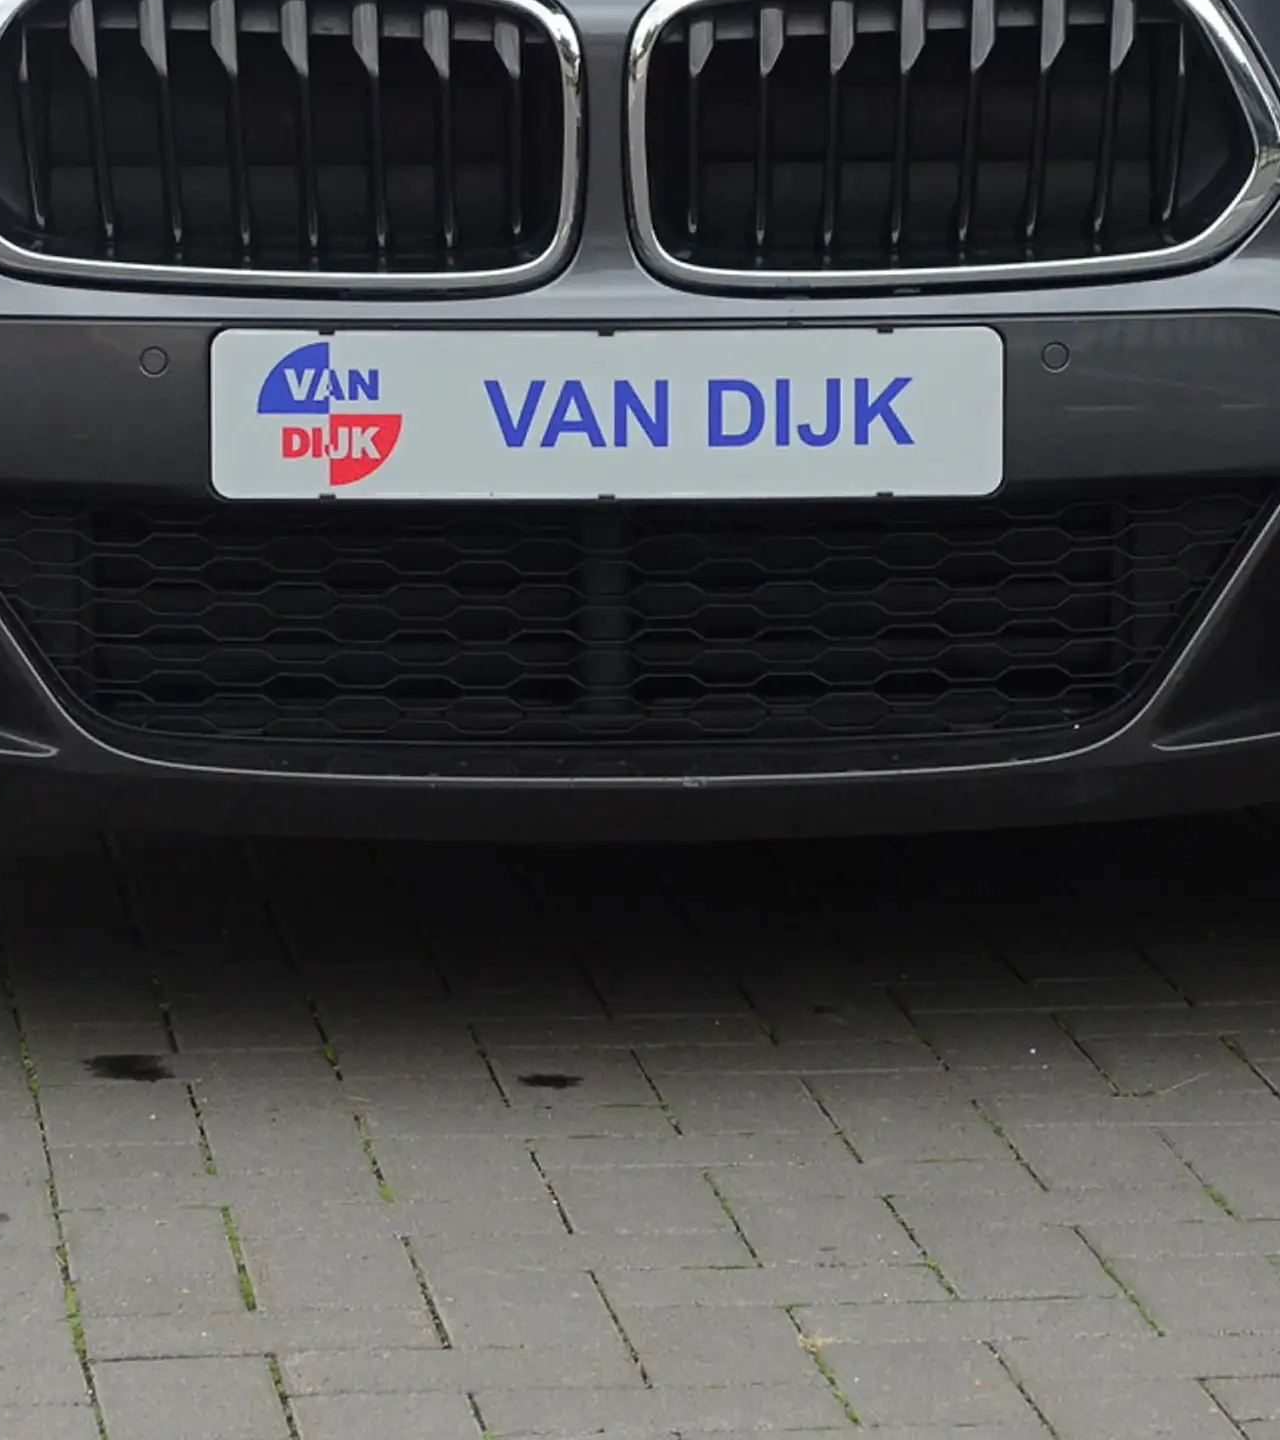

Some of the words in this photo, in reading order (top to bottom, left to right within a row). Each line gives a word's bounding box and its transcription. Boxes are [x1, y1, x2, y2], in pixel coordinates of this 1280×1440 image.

[283, 368, 380, 402] VAN
[484, 379, 669, 448] VAN
[708, 376, 916, 448] DIJK
[281, 426, 382, 459] DIJK
